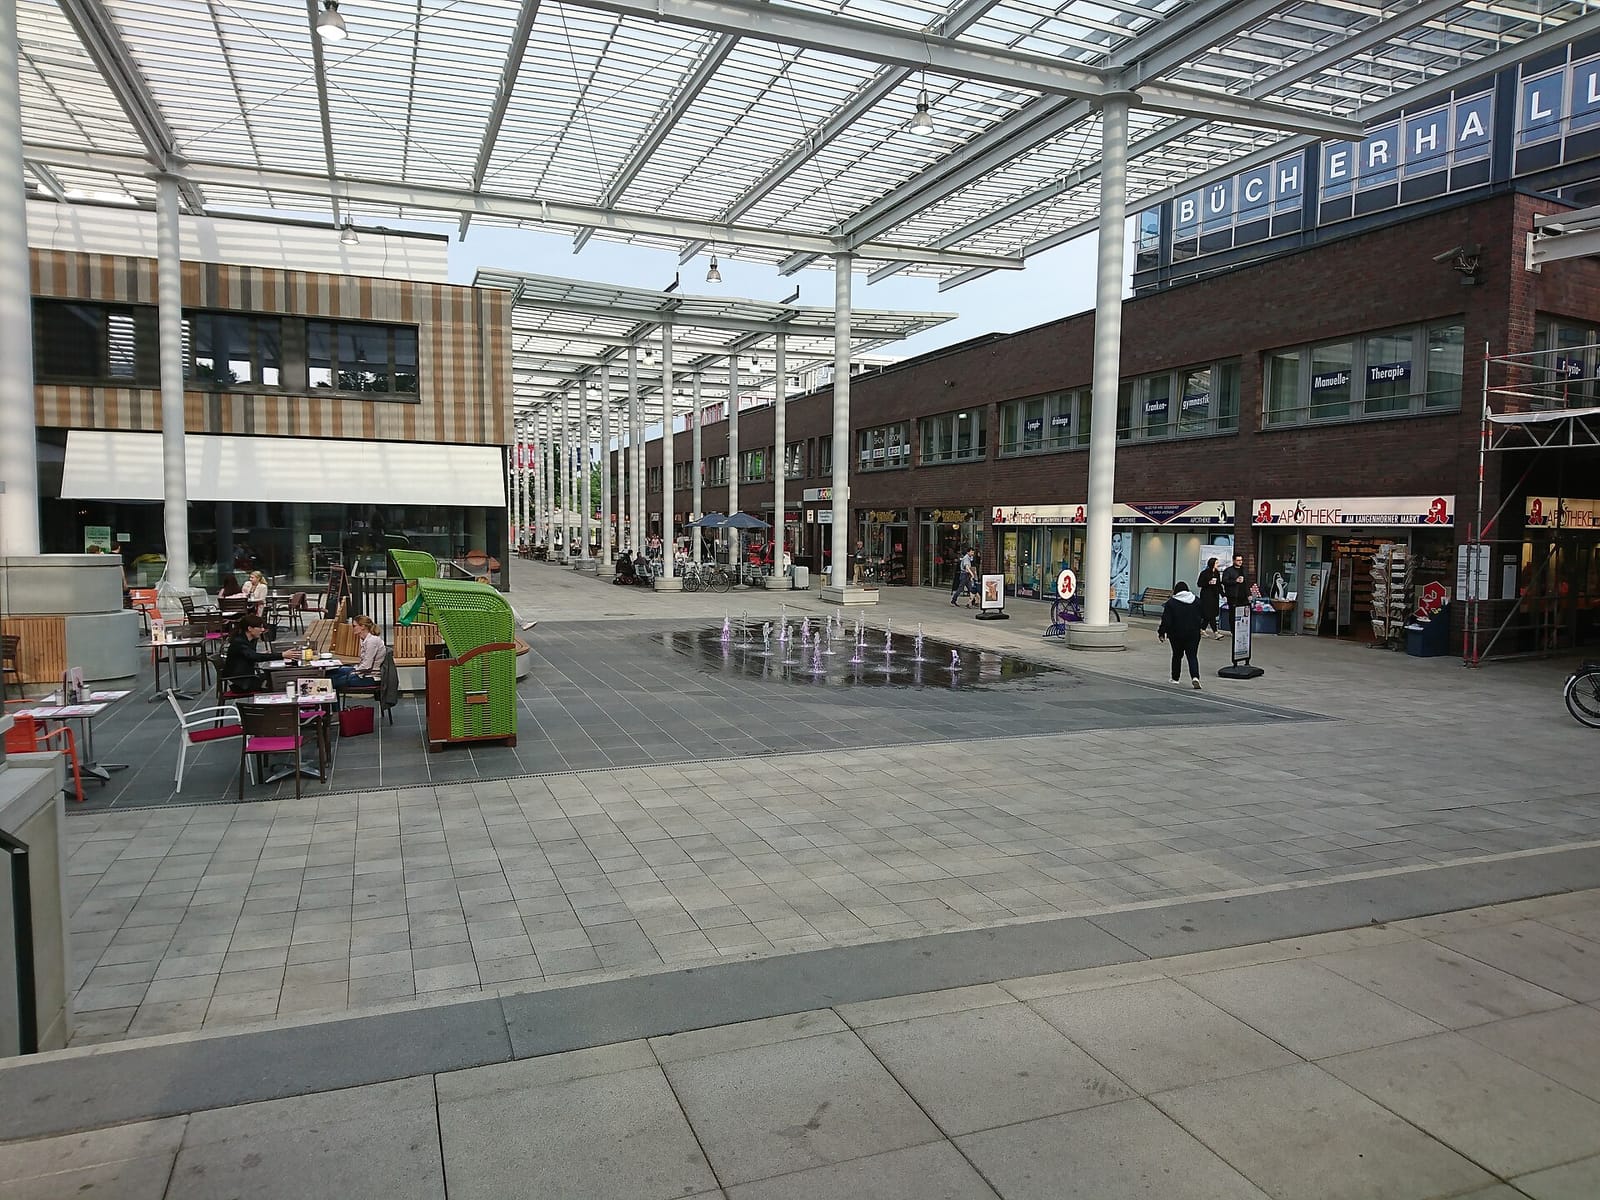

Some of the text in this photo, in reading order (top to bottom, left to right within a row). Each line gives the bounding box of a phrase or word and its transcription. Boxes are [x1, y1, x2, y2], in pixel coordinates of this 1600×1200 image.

[1314, 365, 1405, 389] Manuelle- Therapie
[1182, 393, 1210, 410] gymnastik
[1278, 508, 1342, 524] APOTHEKE
[1345, 515, 1354, 524] AM
[1400, 515, 1420, 524] MARKT
